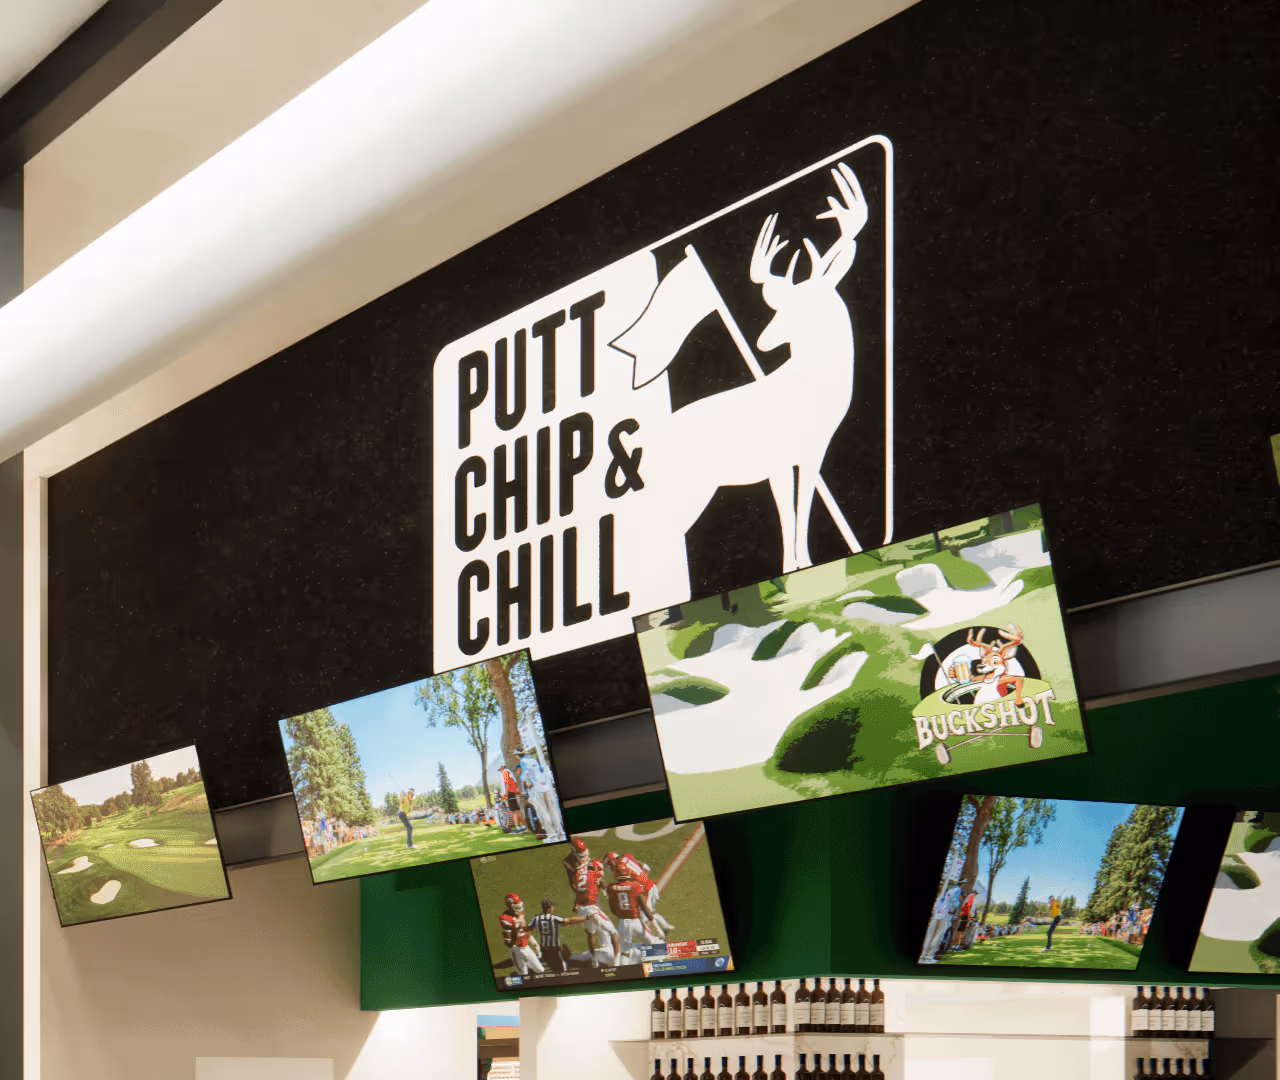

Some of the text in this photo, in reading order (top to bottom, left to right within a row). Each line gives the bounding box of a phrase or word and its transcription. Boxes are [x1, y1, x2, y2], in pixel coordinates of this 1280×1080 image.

[457, 289, 606, 450] PUTT
[454, 411, 646, 553] CHIP &
[457, 513, 631, 657] CHILL
[912, 687, 1057, 751] BUCKSHOT
